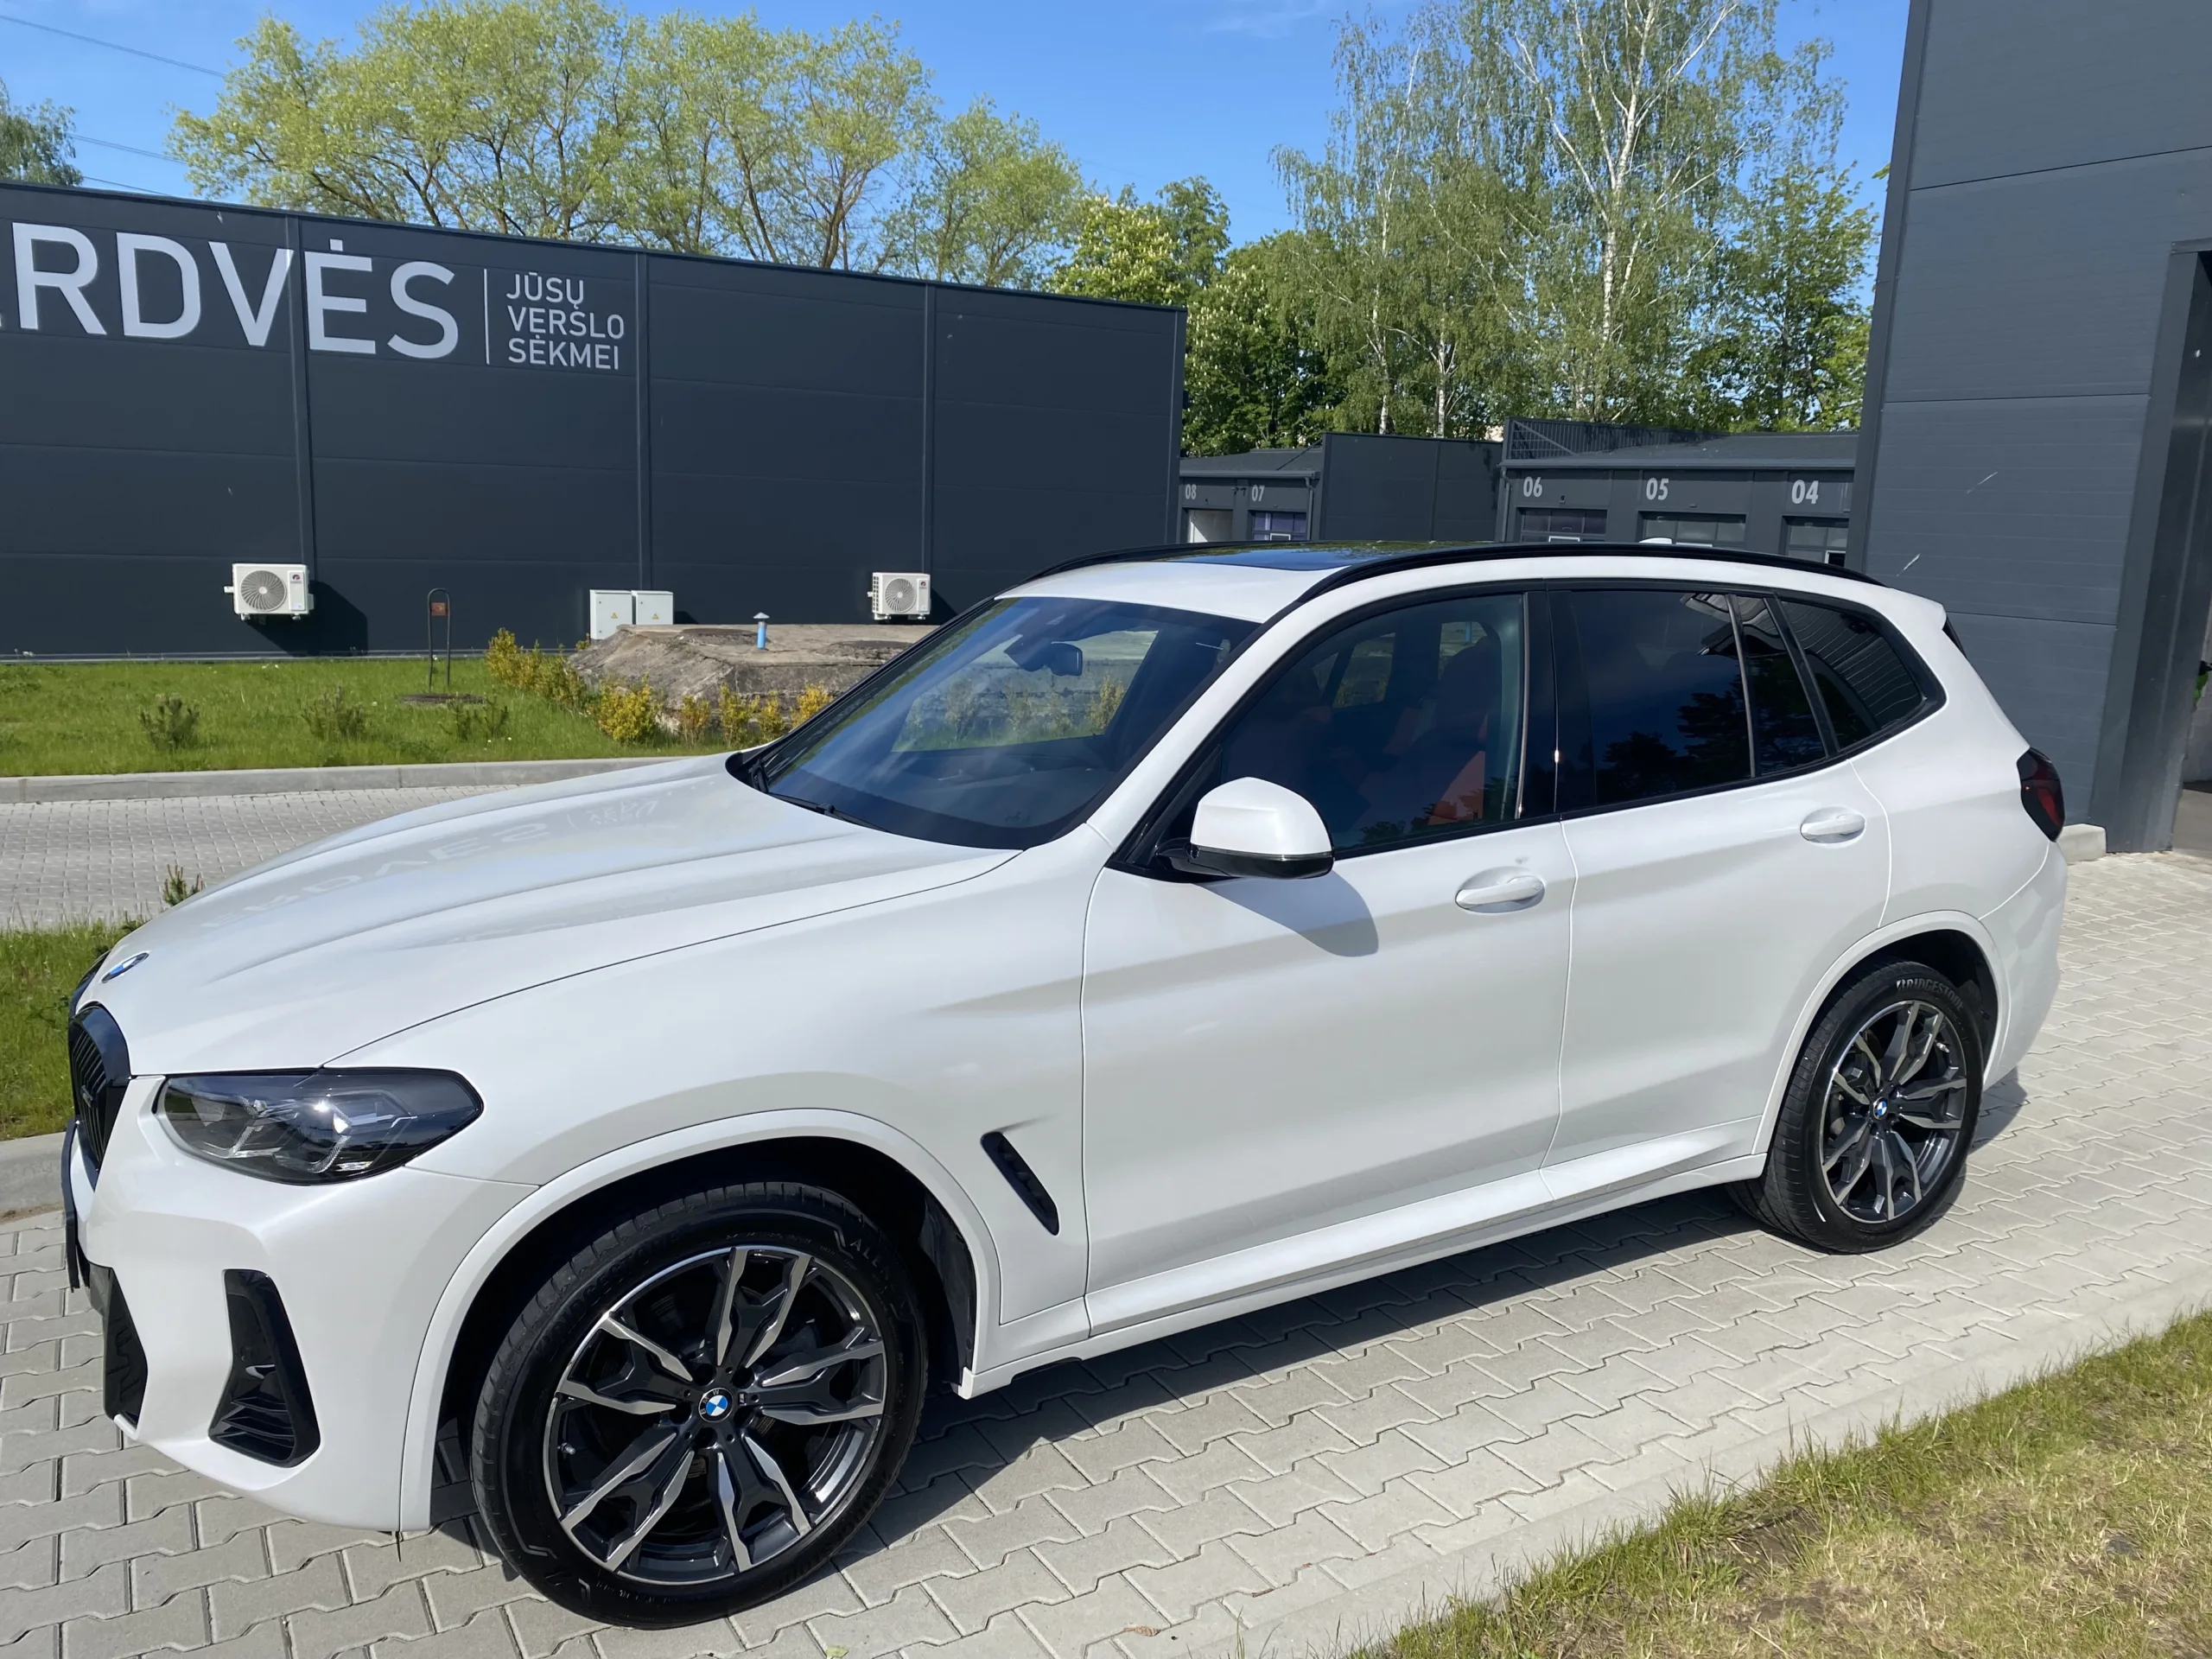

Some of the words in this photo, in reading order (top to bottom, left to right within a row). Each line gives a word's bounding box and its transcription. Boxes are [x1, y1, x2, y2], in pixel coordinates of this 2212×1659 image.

[0, 222, 459, 359] RDVĖS
[506, 272, 584, 309] JŪSŲ
[507, 305, 624, 340] VERSLO
[508, 334, 619, 370] SĖKMEI
[1185, 484, 1197, 499] 08
[1251, 485, 1265, 501] 07
[1523, 476, 1542, 498] 06
[1646, 477, 1669, 500] 05
[1791, 480, 1819, 505] 04
